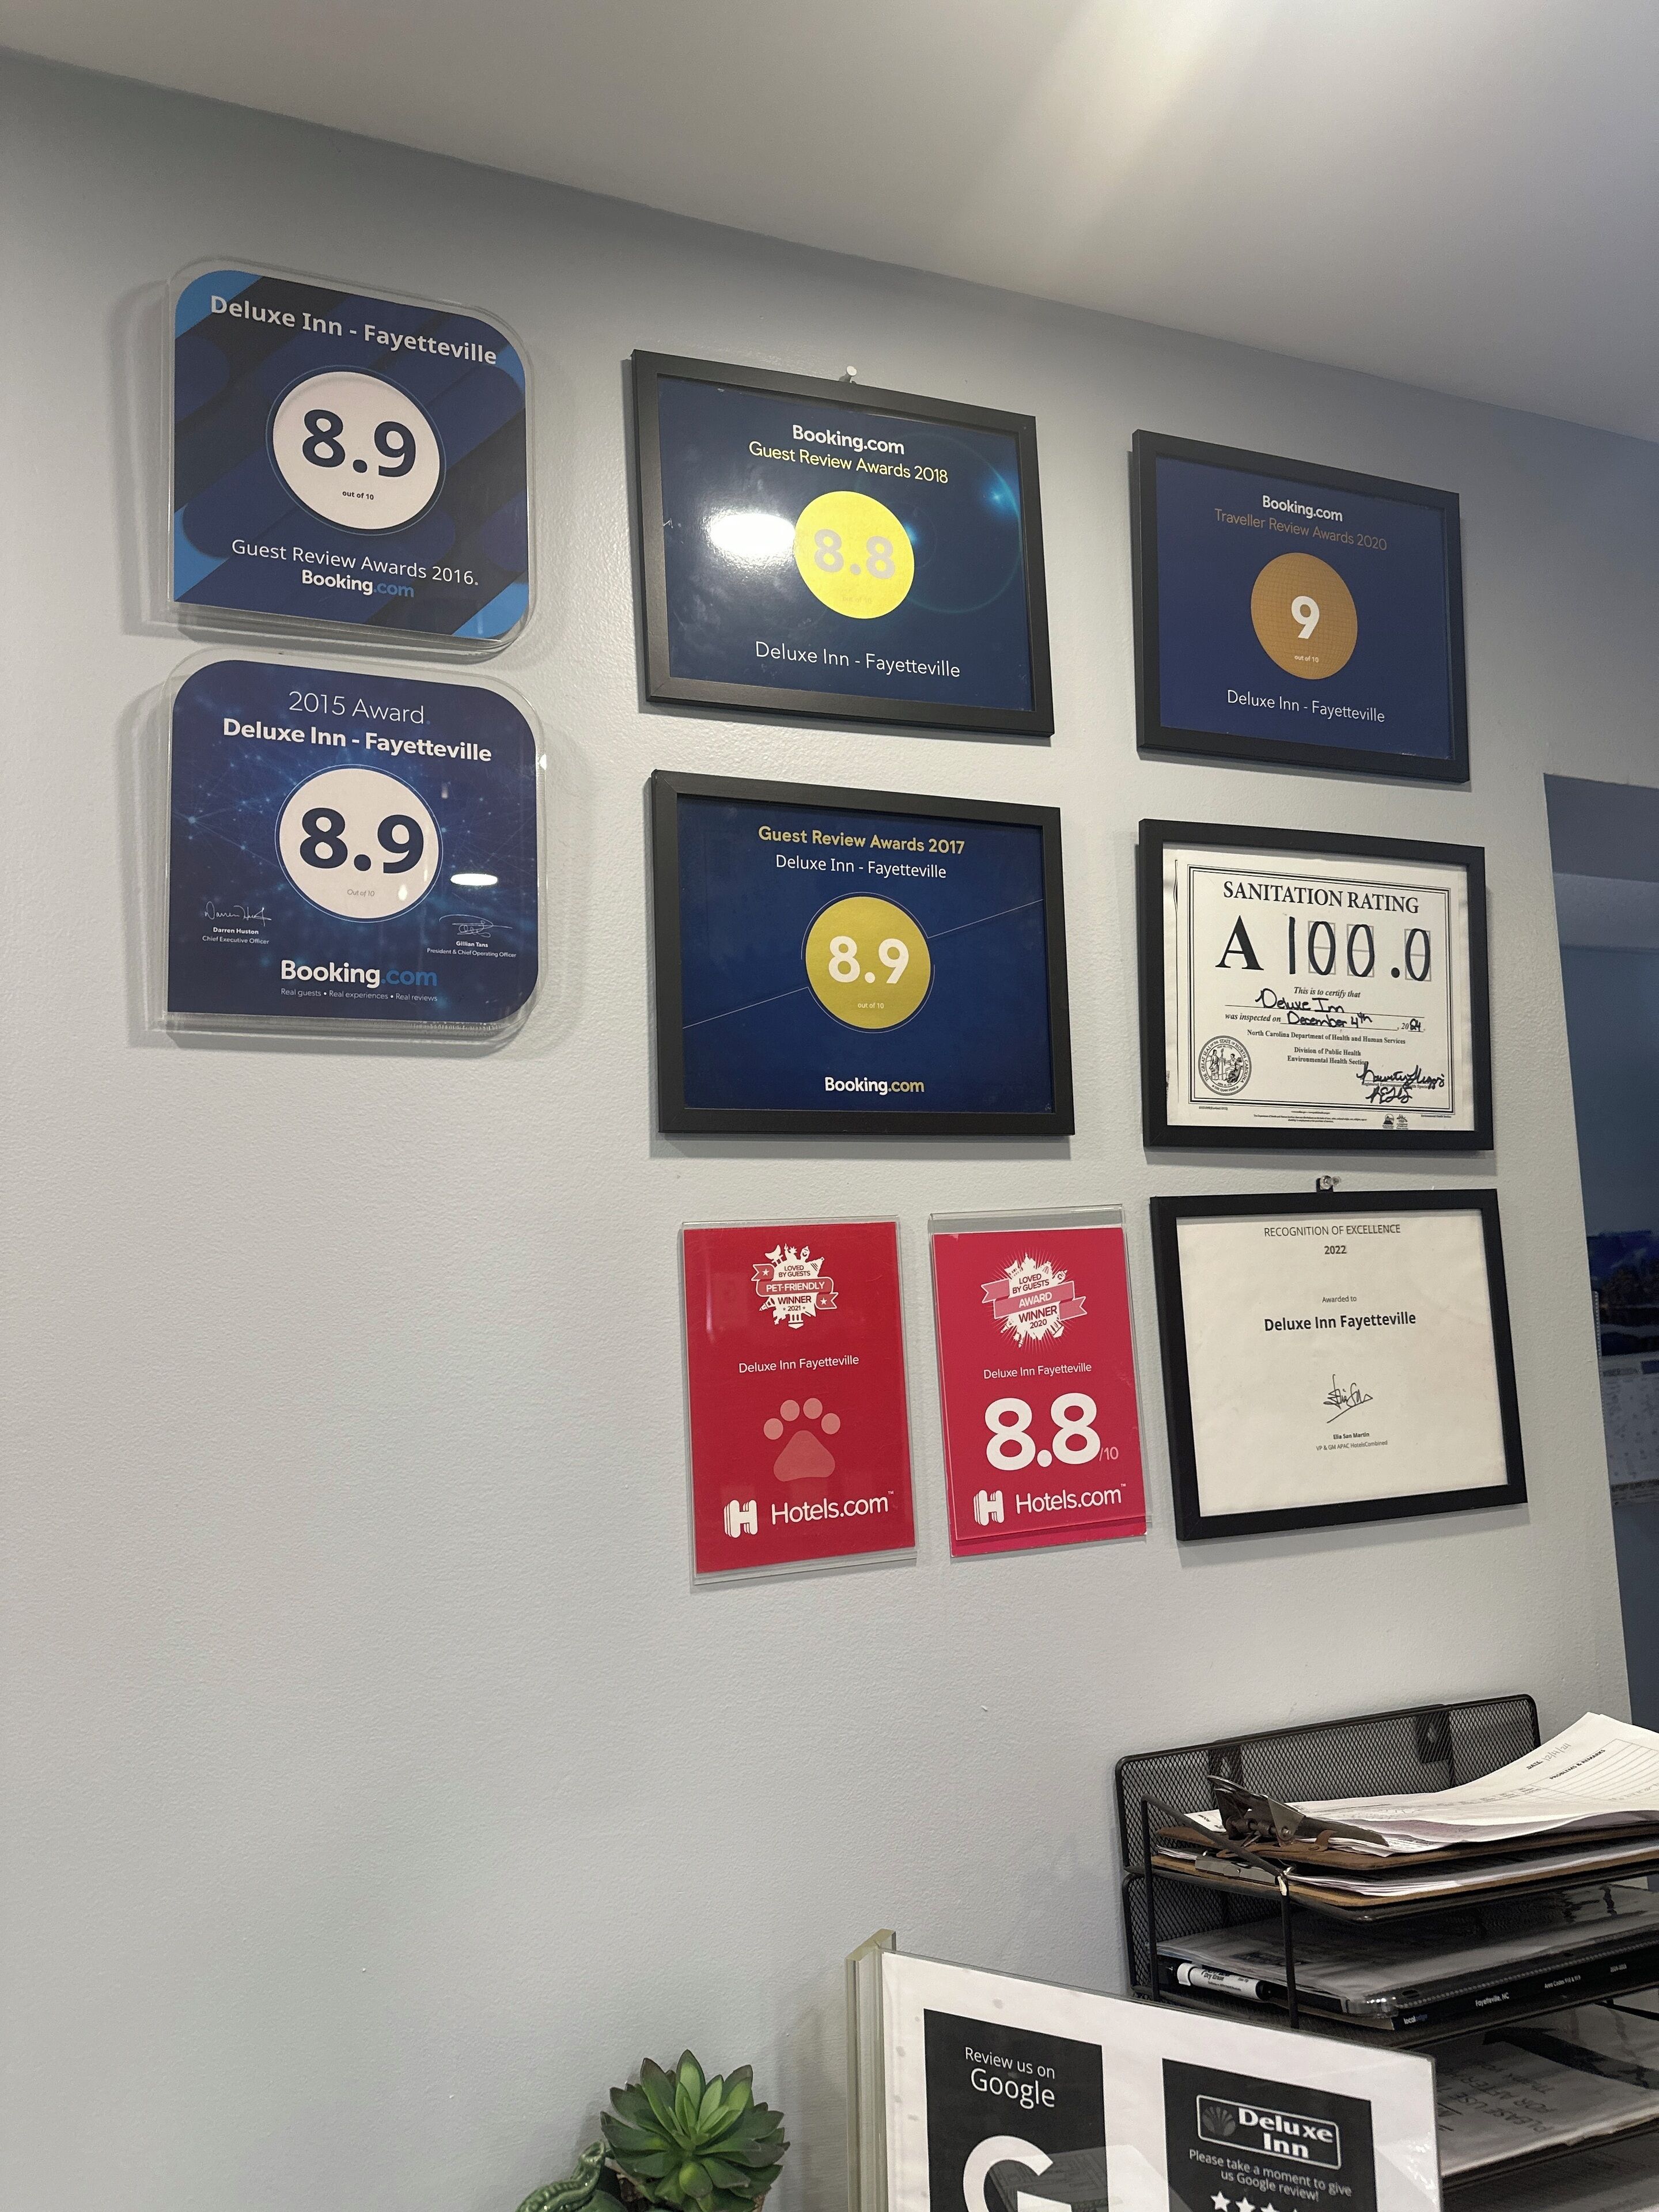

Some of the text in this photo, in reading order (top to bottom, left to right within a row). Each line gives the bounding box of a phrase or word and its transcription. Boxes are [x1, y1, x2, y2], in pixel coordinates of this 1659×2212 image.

[211, 295, 497, 364] Deluxe Inn Fayetteville
[301, 409, 416, 478] 8.9
[792, 425, 905, 454] Booking.com
[749, 441, 948, 483] Guest Review Awards 2018
[342, 490, 354, 498] out
[1263, 494, 1343, 522] Booking.com
[1214, 507, 1388, 551] Traveller Review Awards 2020
[232, 539, 287, 560] Guest
[292, 547, 356, 569] Review
[361, 556, 426, 578] Awards
[814, 529, 895, 579] 8.8
[301, 569, 415, 598] Booking.com
[1291, 596, 1320, 639] 9
[755, 641, 961, 678] Deluxe Inn Fayetteville
[289, 691, 425, 725] 2015 Award
[1227, 690, 1386, 724] Deluxe Inn Fayetteville
[223, 718, 492, 762] Deluxe Inn Fayetteville
[299, 807, 425, 874] 8.9
[757, 825, 965, 855] Guest Review Awards 2017
[776, 854, 947, 880] Deluxe Inn Fayetteville
[347, 888, 359, 896] Out
[1223, 881, 1419, 914] SANITATION RATING
[219, 935, 248, 944] Executive
[1215, 915, 1264, 971] A
[1288, 916, 1431, 982] 100.0
[472, 950, 498, 958] Operating
[827, 935, 910, 985] 8.9
[281, 959, 438, 988] Booking.com
[281, 988, 438, 1002] Real guests Real experiences Real reviews
[1294, 986, 1309, 995] This
[1310, 987, 1316, 995] is
[1325, 990, 1346, 998] certify
[1347, 990, 1361, 998] that
[1239, 1013, 1271, 1023] inspected
[1247, 1029, 1264, 1037] North
[1265, 1030, 1290, 1039] Carolina
[1290, 1031, 1324, 1041] Department
[1332, 1033, 1350, 1042] Health
[1362, 1035, 1382, 1044] Human
[1383, 1036, 1406, 1045] Services
[1287, 1055, 1347, 1065] Environmental Health
[1325, 1047, 1342, 1056] Public
[1343, 1048, 1361, 1056] Health
[824, 1076, 925, 1096] Booking.com
[1264, 1224, 1402, 1237] RECOGNITION OF EXCELLENCE
[1324, 1245, 1347, 1255] 2022
[766, 1281, 825, 1293] PET-FRIENDLY
[1012, 1279, 1050, 1294] BY GUESTS
[1018, 1274, 1042, 1285] LOVED
[778, 1296, 812, 1305] WINNER
[1018, 1291, 1053, 1309] AWARD
[1322, 1296, 1350, 1304] Awarded
[1018, 1305, 1058, 1324] WINNER
[1029, 1319, 1047, 1330] 2020
[1264, 1311, 1416, 1332] Deluxe Inn Fayetteville
[738, 1354, 860, 1374] Deluxe Inn Fayetteville
[983, 1361, 1092, 1380] Deluxe Inn Fayetteville
[984, 1392, 1101, 1471] 8.8
[1350, 1440, 1388, 1449] HotelsCombined
[771, 1496, 889, 1525] Hotels.com
[1016, 1488, 1122, 1514] Hotels.com
[965, 2047, 1056, 2080] Review us on
[971, 2068, 1056, 2110] Google
[1238, 2107, 1334, 2143] Deluxe
[1263, 2133, 1309, 2159] Inn
[1189, 2149, 1353, 2197] Please take moment to give
[1221, 2169, 1320, 2202] us Google review!
